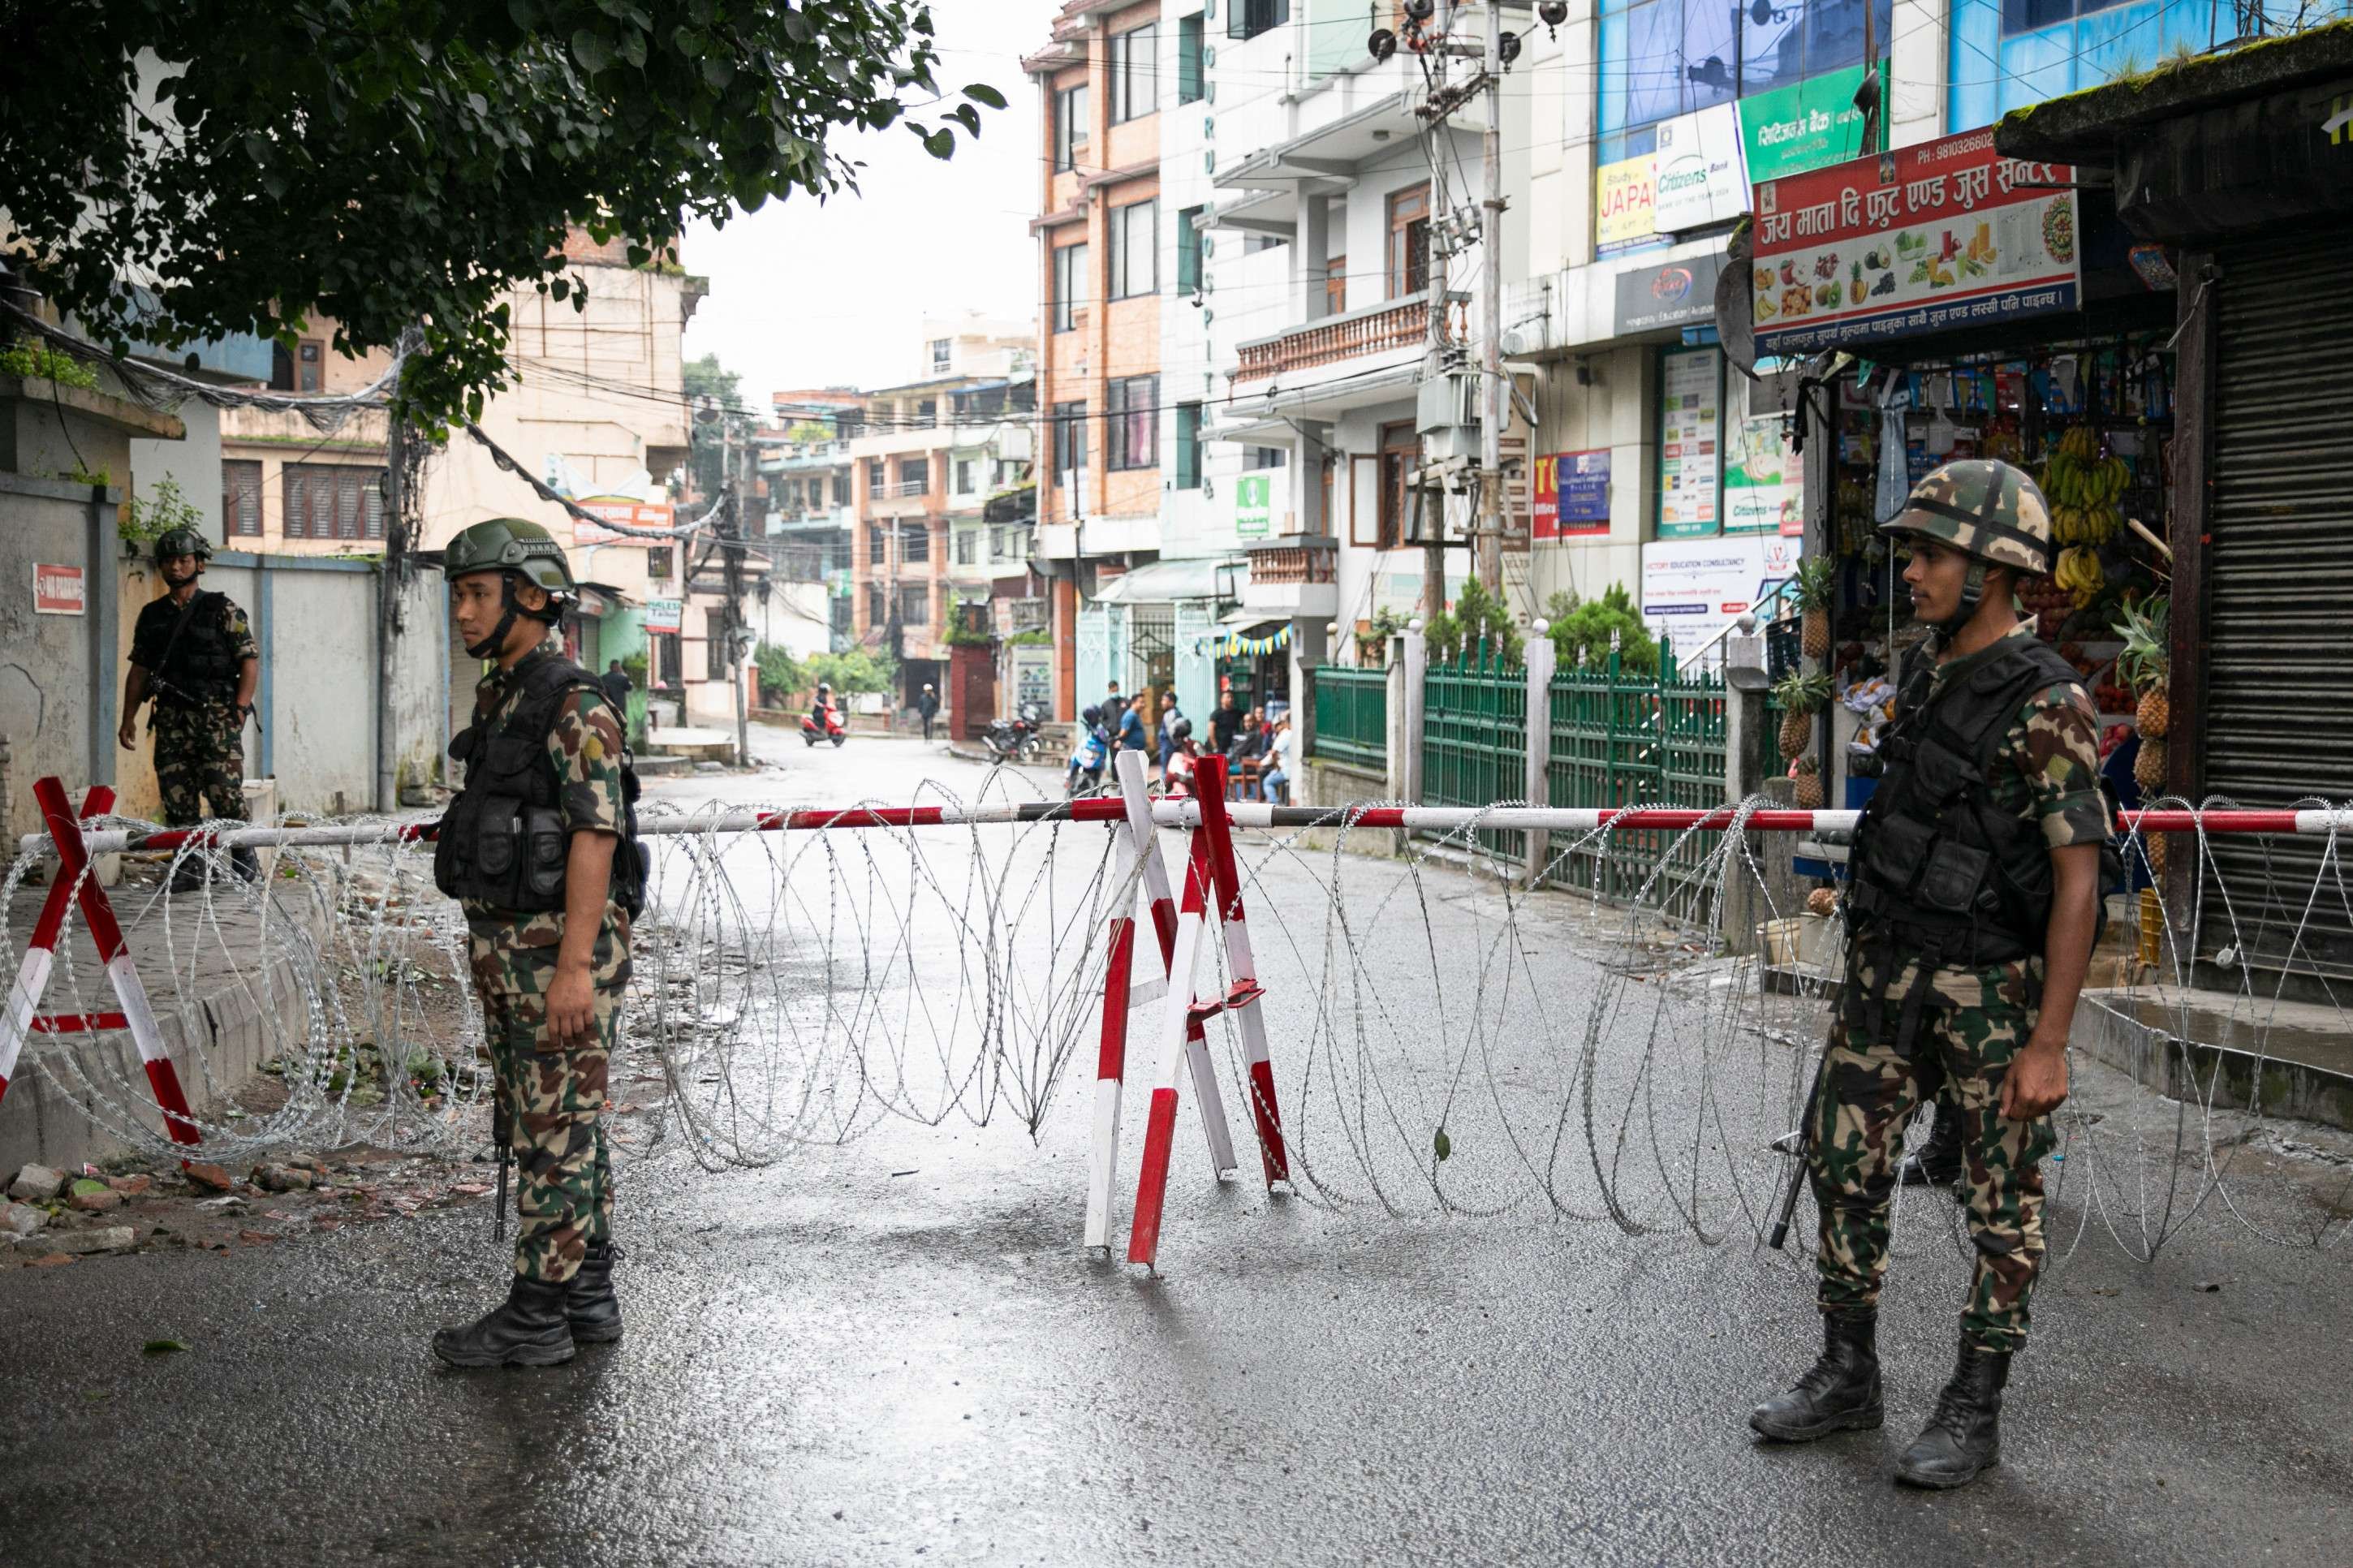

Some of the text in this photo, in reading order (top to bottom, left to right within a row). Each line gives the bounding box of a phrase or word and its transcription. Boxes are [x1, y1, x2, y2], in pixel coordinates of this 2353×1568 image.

[1917, 150, 1930, 164] PH
[1937, 132, 1994, 160] 9810326602
[1658, 161, 1728, 194] Citizens Bank
[1601, 179, 1657, 218] JAPA
[1760, 212, 1792, 245] जय
[1796, 201, 1836, 235] माता
[1841, 187, 1861, 228] दि
[1906, 174, 1947, 213] एण्ड
[1952, 165, 1990, 210] जुस
[1929, 309, 1947, 327] जुस
[1949, 306, 1969, 320] एण्ड
[2001, 295, 2019, 311] पनि
[1670, 560, 1701, 569] EDUCATION
[1702, 558, 1745, 567] CONSULTANCY
